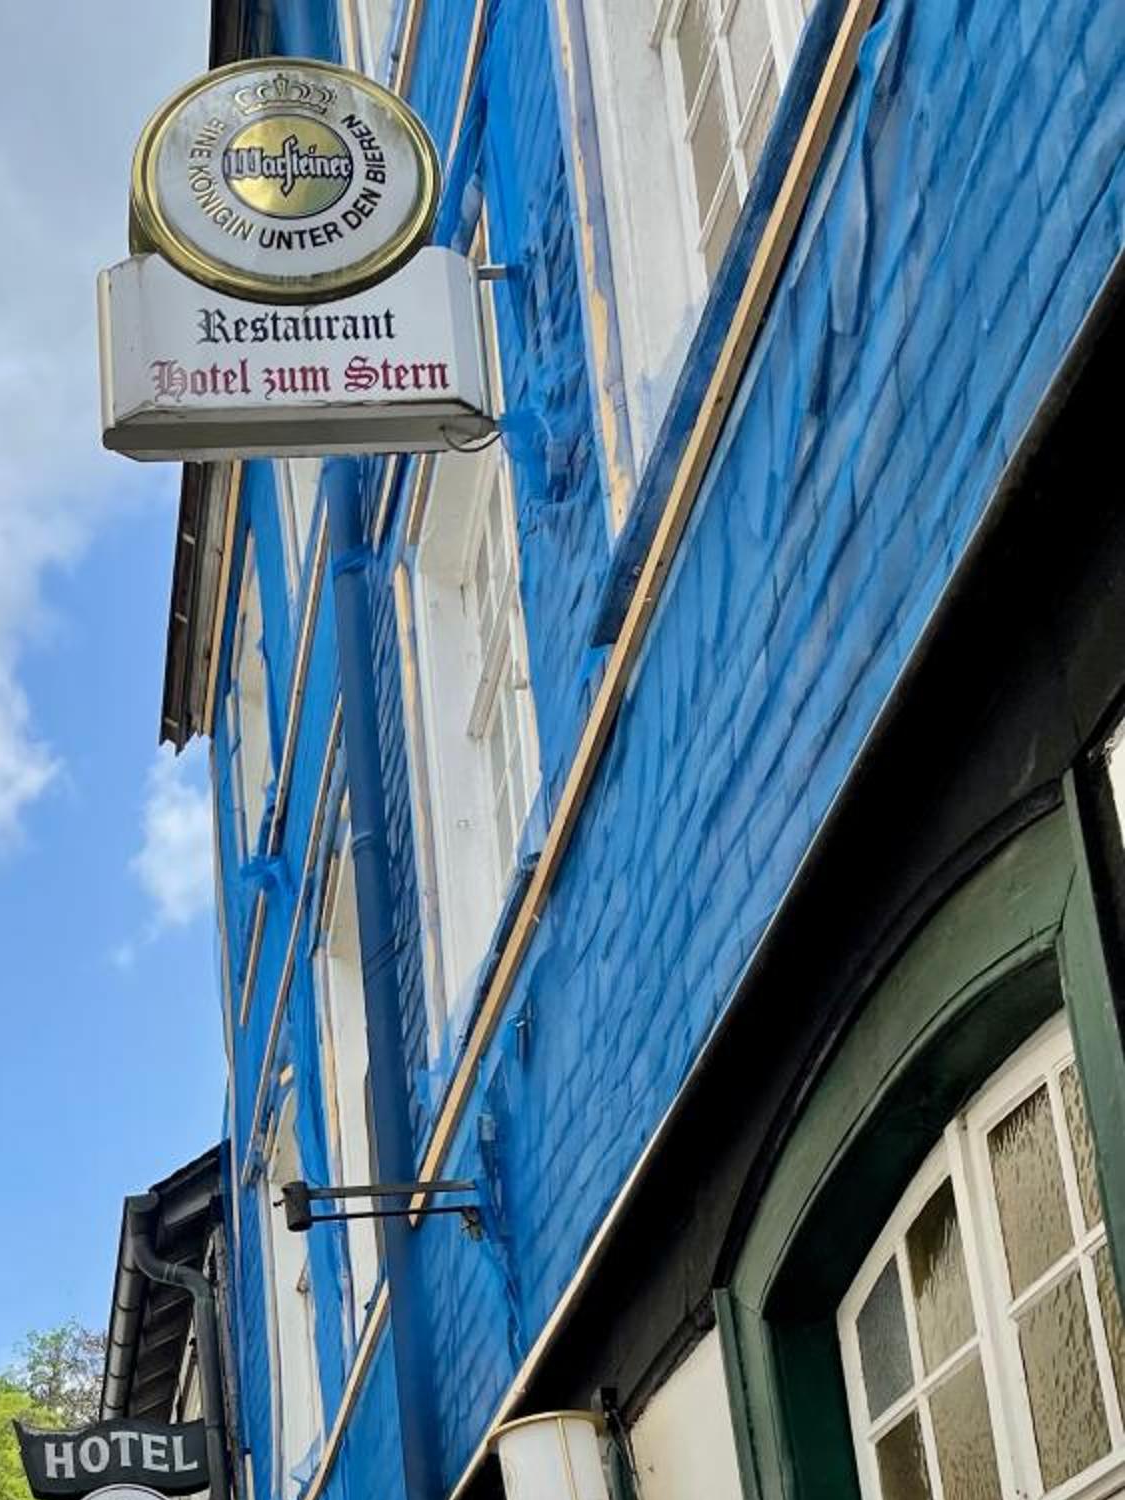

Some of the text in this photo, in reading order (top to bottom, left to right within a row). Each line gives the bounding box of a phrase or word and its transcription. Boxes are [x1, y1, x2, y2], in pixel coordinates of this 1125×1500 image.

[188, 114, 386, 250] EINE KÖNIGIN UNTER DEN BIEREN
[222, 134, 353, 197] Warsteiner
[196, 307, 396, 345] Restaurant
[151, 355, 451, 402] Hotel zum Stern
[44, 1431, 198, 1479] HOTEL
